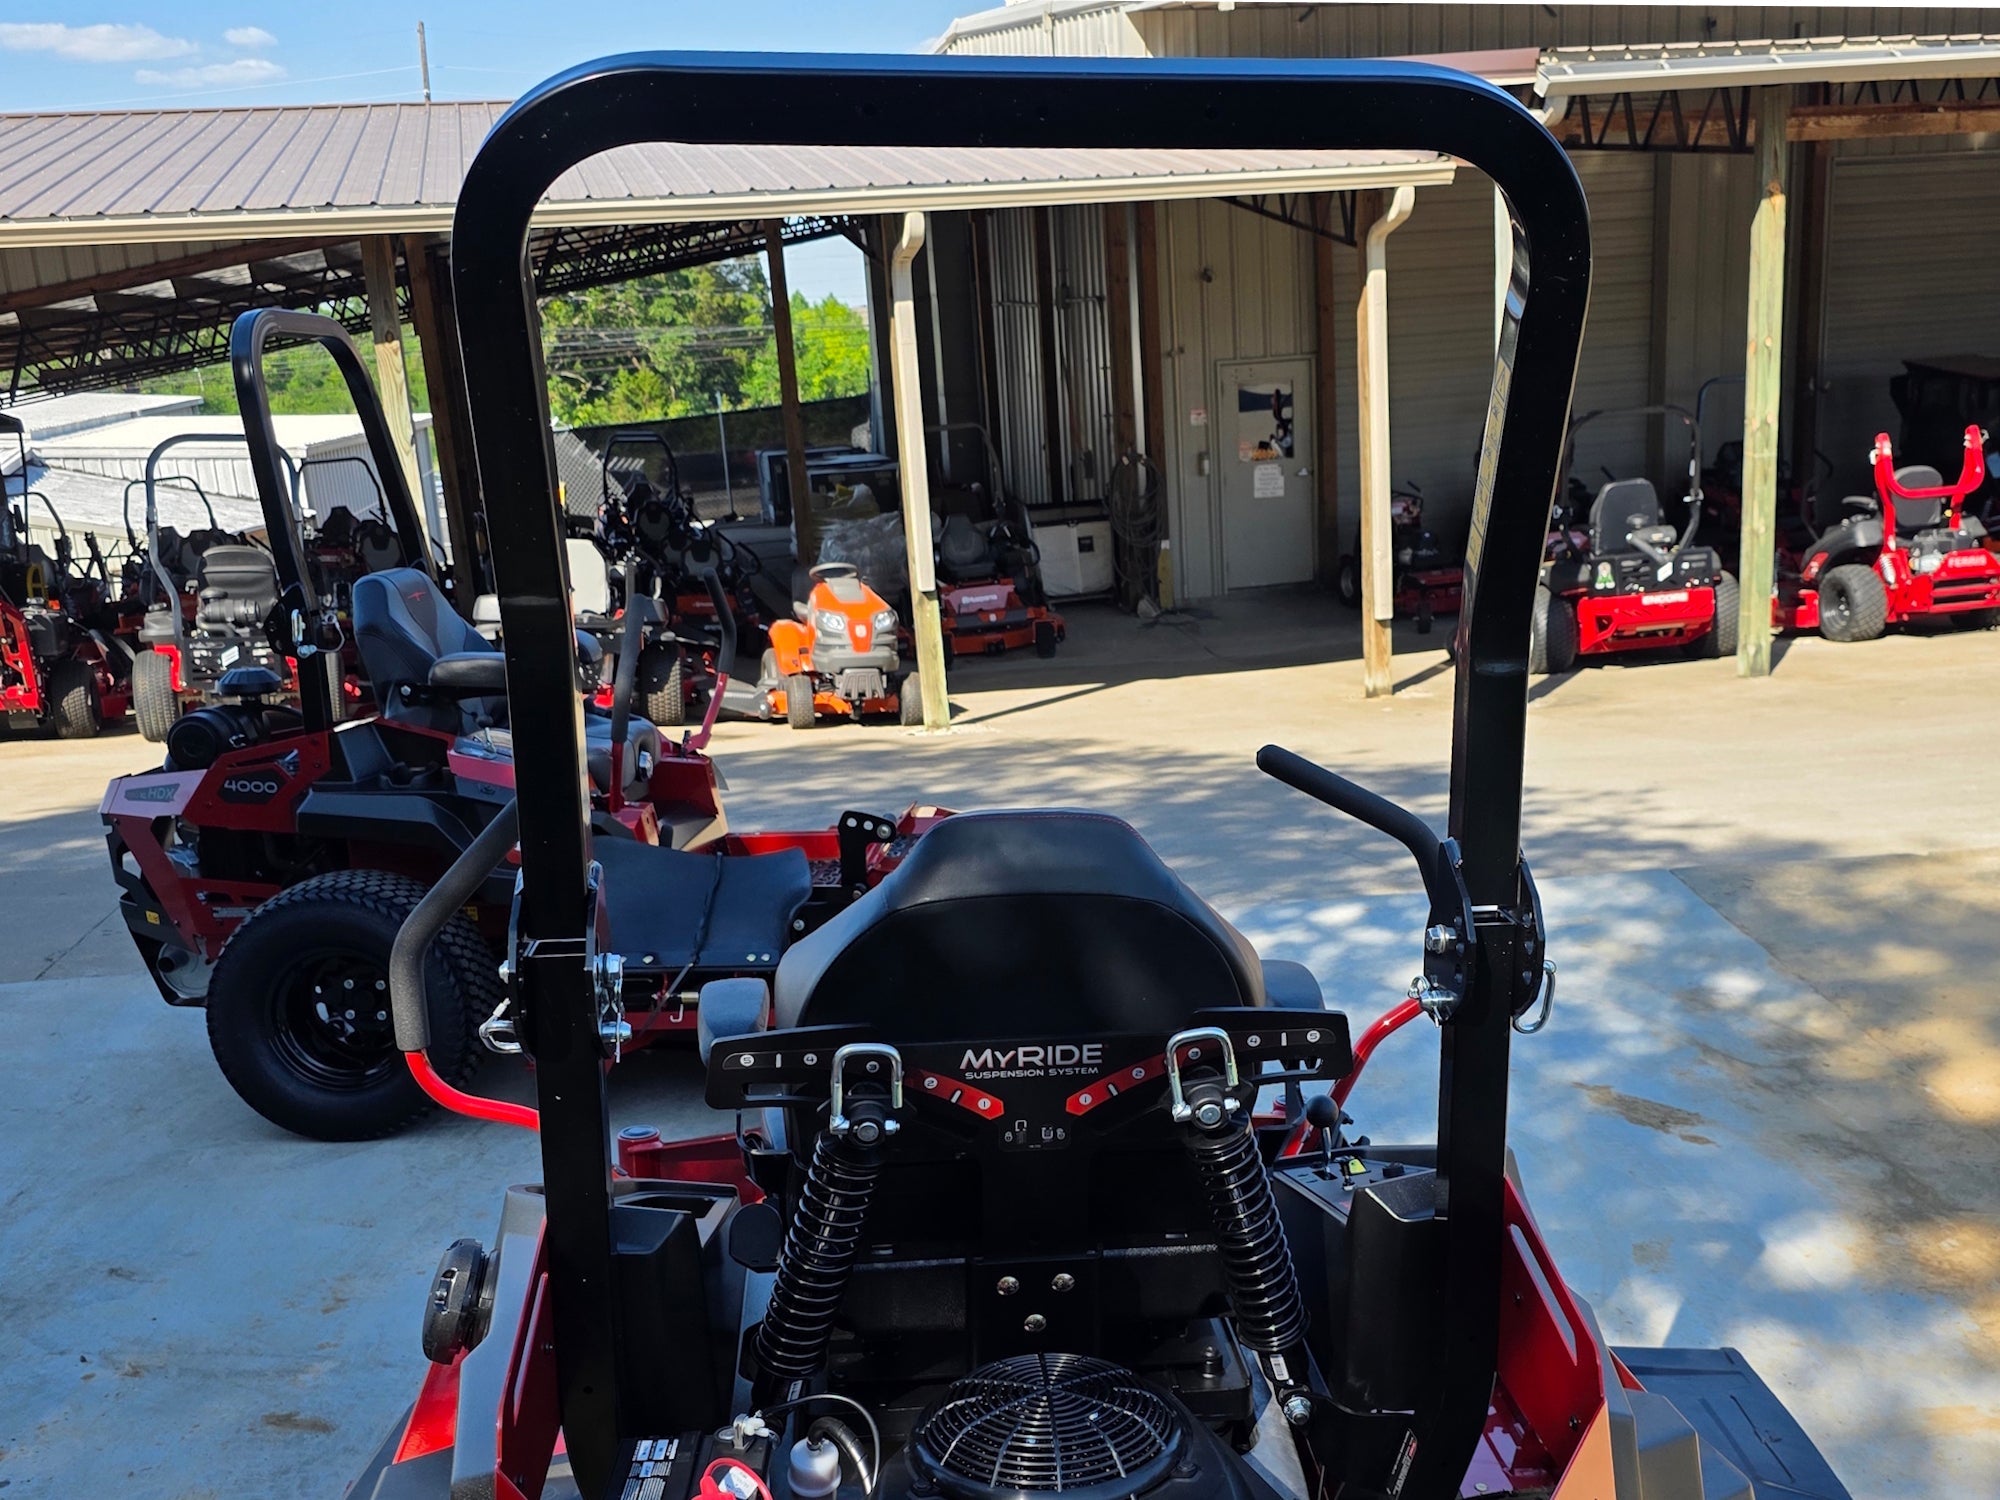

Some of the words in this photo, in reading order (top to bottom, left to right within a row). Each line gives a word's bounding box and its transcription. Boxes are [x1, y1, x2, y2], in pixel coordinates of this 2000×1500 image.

[223, 780, 278, 794] 4000
[965, 1069, 1044, 1080] SUSPENSION
[1048, 1067, 1099, 1077] SYSTEM
